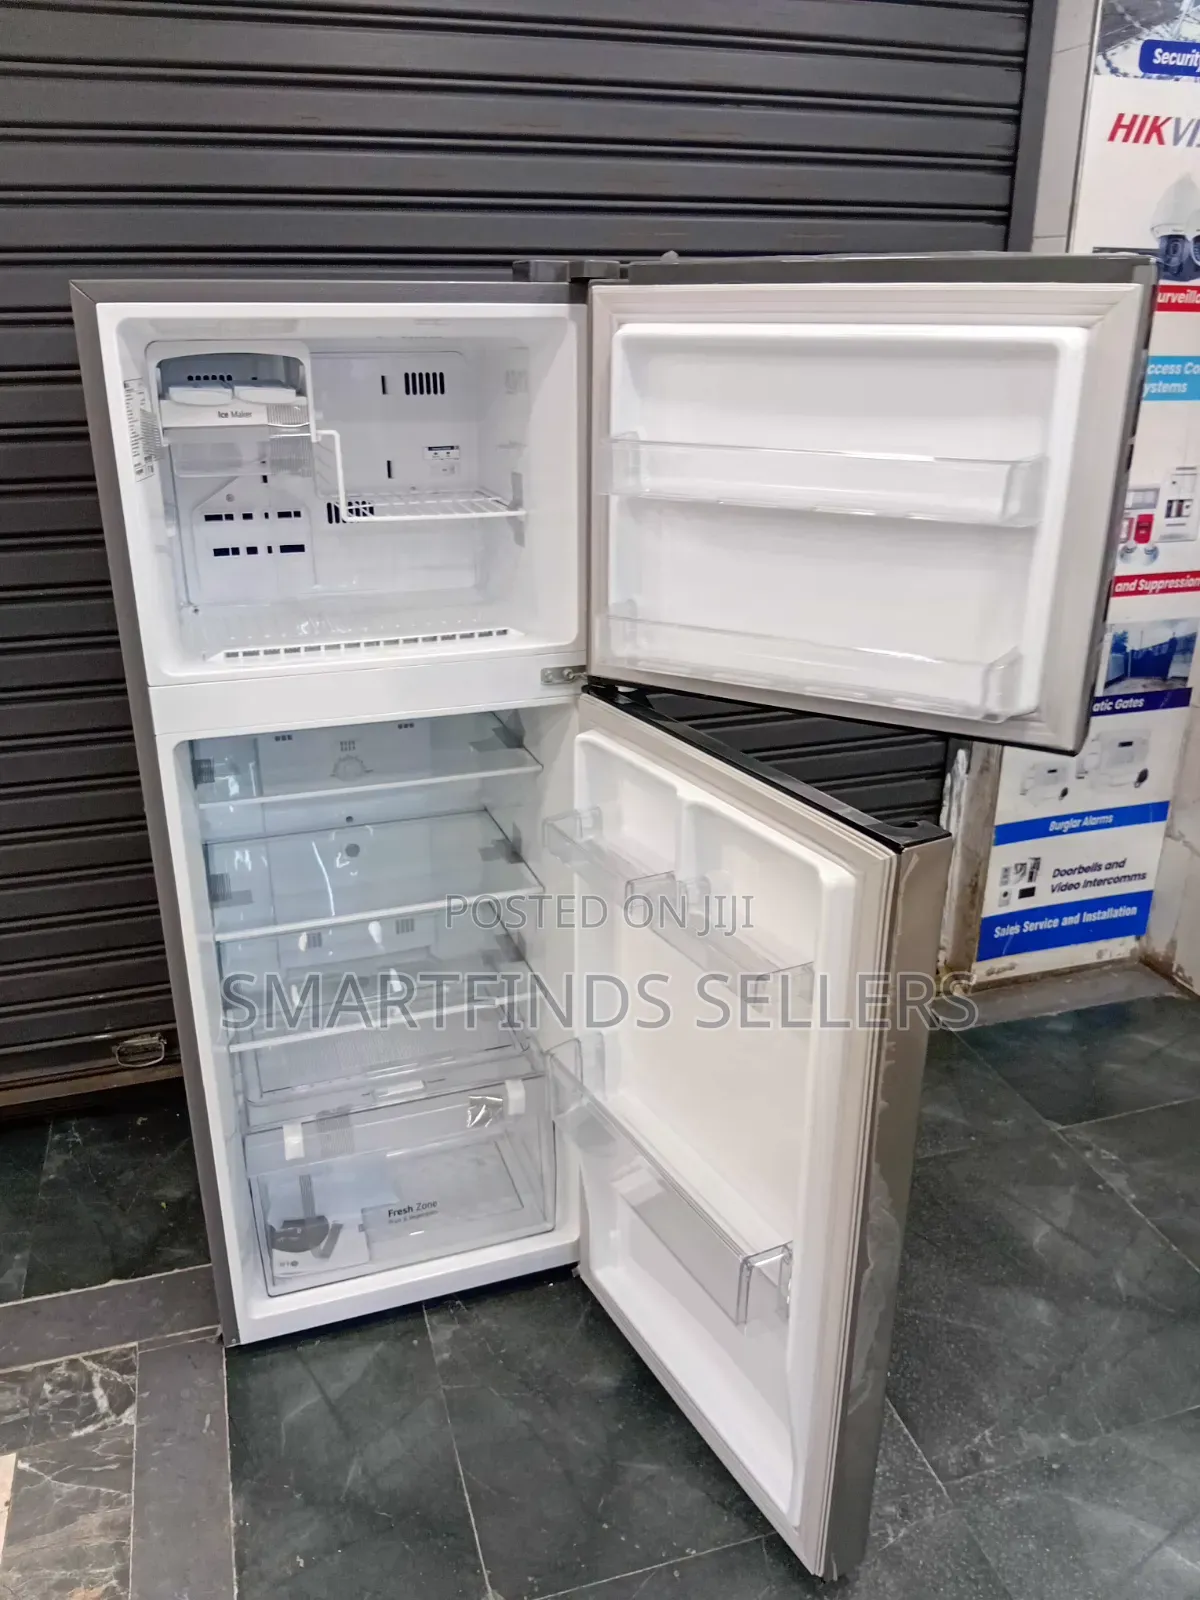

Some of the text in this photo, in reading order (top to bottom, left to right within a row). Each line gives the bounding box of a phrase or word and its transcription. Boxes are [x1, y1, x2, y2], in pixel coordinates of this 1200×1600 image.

[1107, 112, 1200, 148] HIKVI
[1115, 580, 1137, 592] and
[1092, 698, 1144, 712] atic Gates
[1049, 815, 1113, 832] Burglar Alarms
[1052, 858, 1126, 878] Doorbells and
[1051, 872, 1147, 893] Video Intercomms
[994, 906, 1137, 938] Sales Service and Installation
[388, 1205, 413, 1217] Fresh
[415, 1201, 437, 1210] Zone
